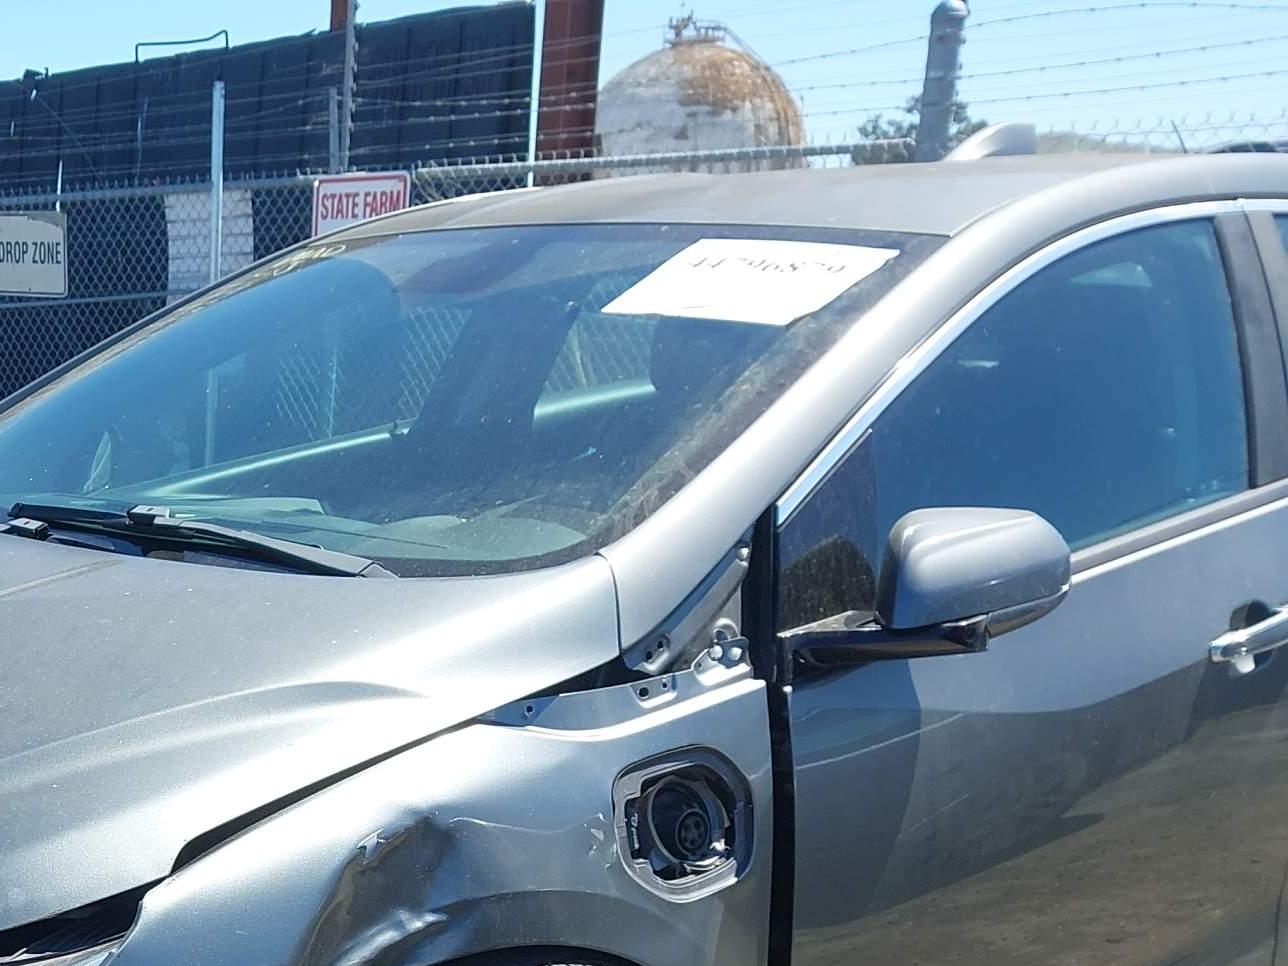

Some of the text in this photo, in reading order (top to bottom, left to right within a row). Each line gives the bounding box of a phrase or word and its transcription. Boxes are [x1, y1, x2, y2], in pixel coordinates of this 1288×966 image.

[320, 189, 402, 220] STATE FARM
[31, 241, 62, 265] ZONE
